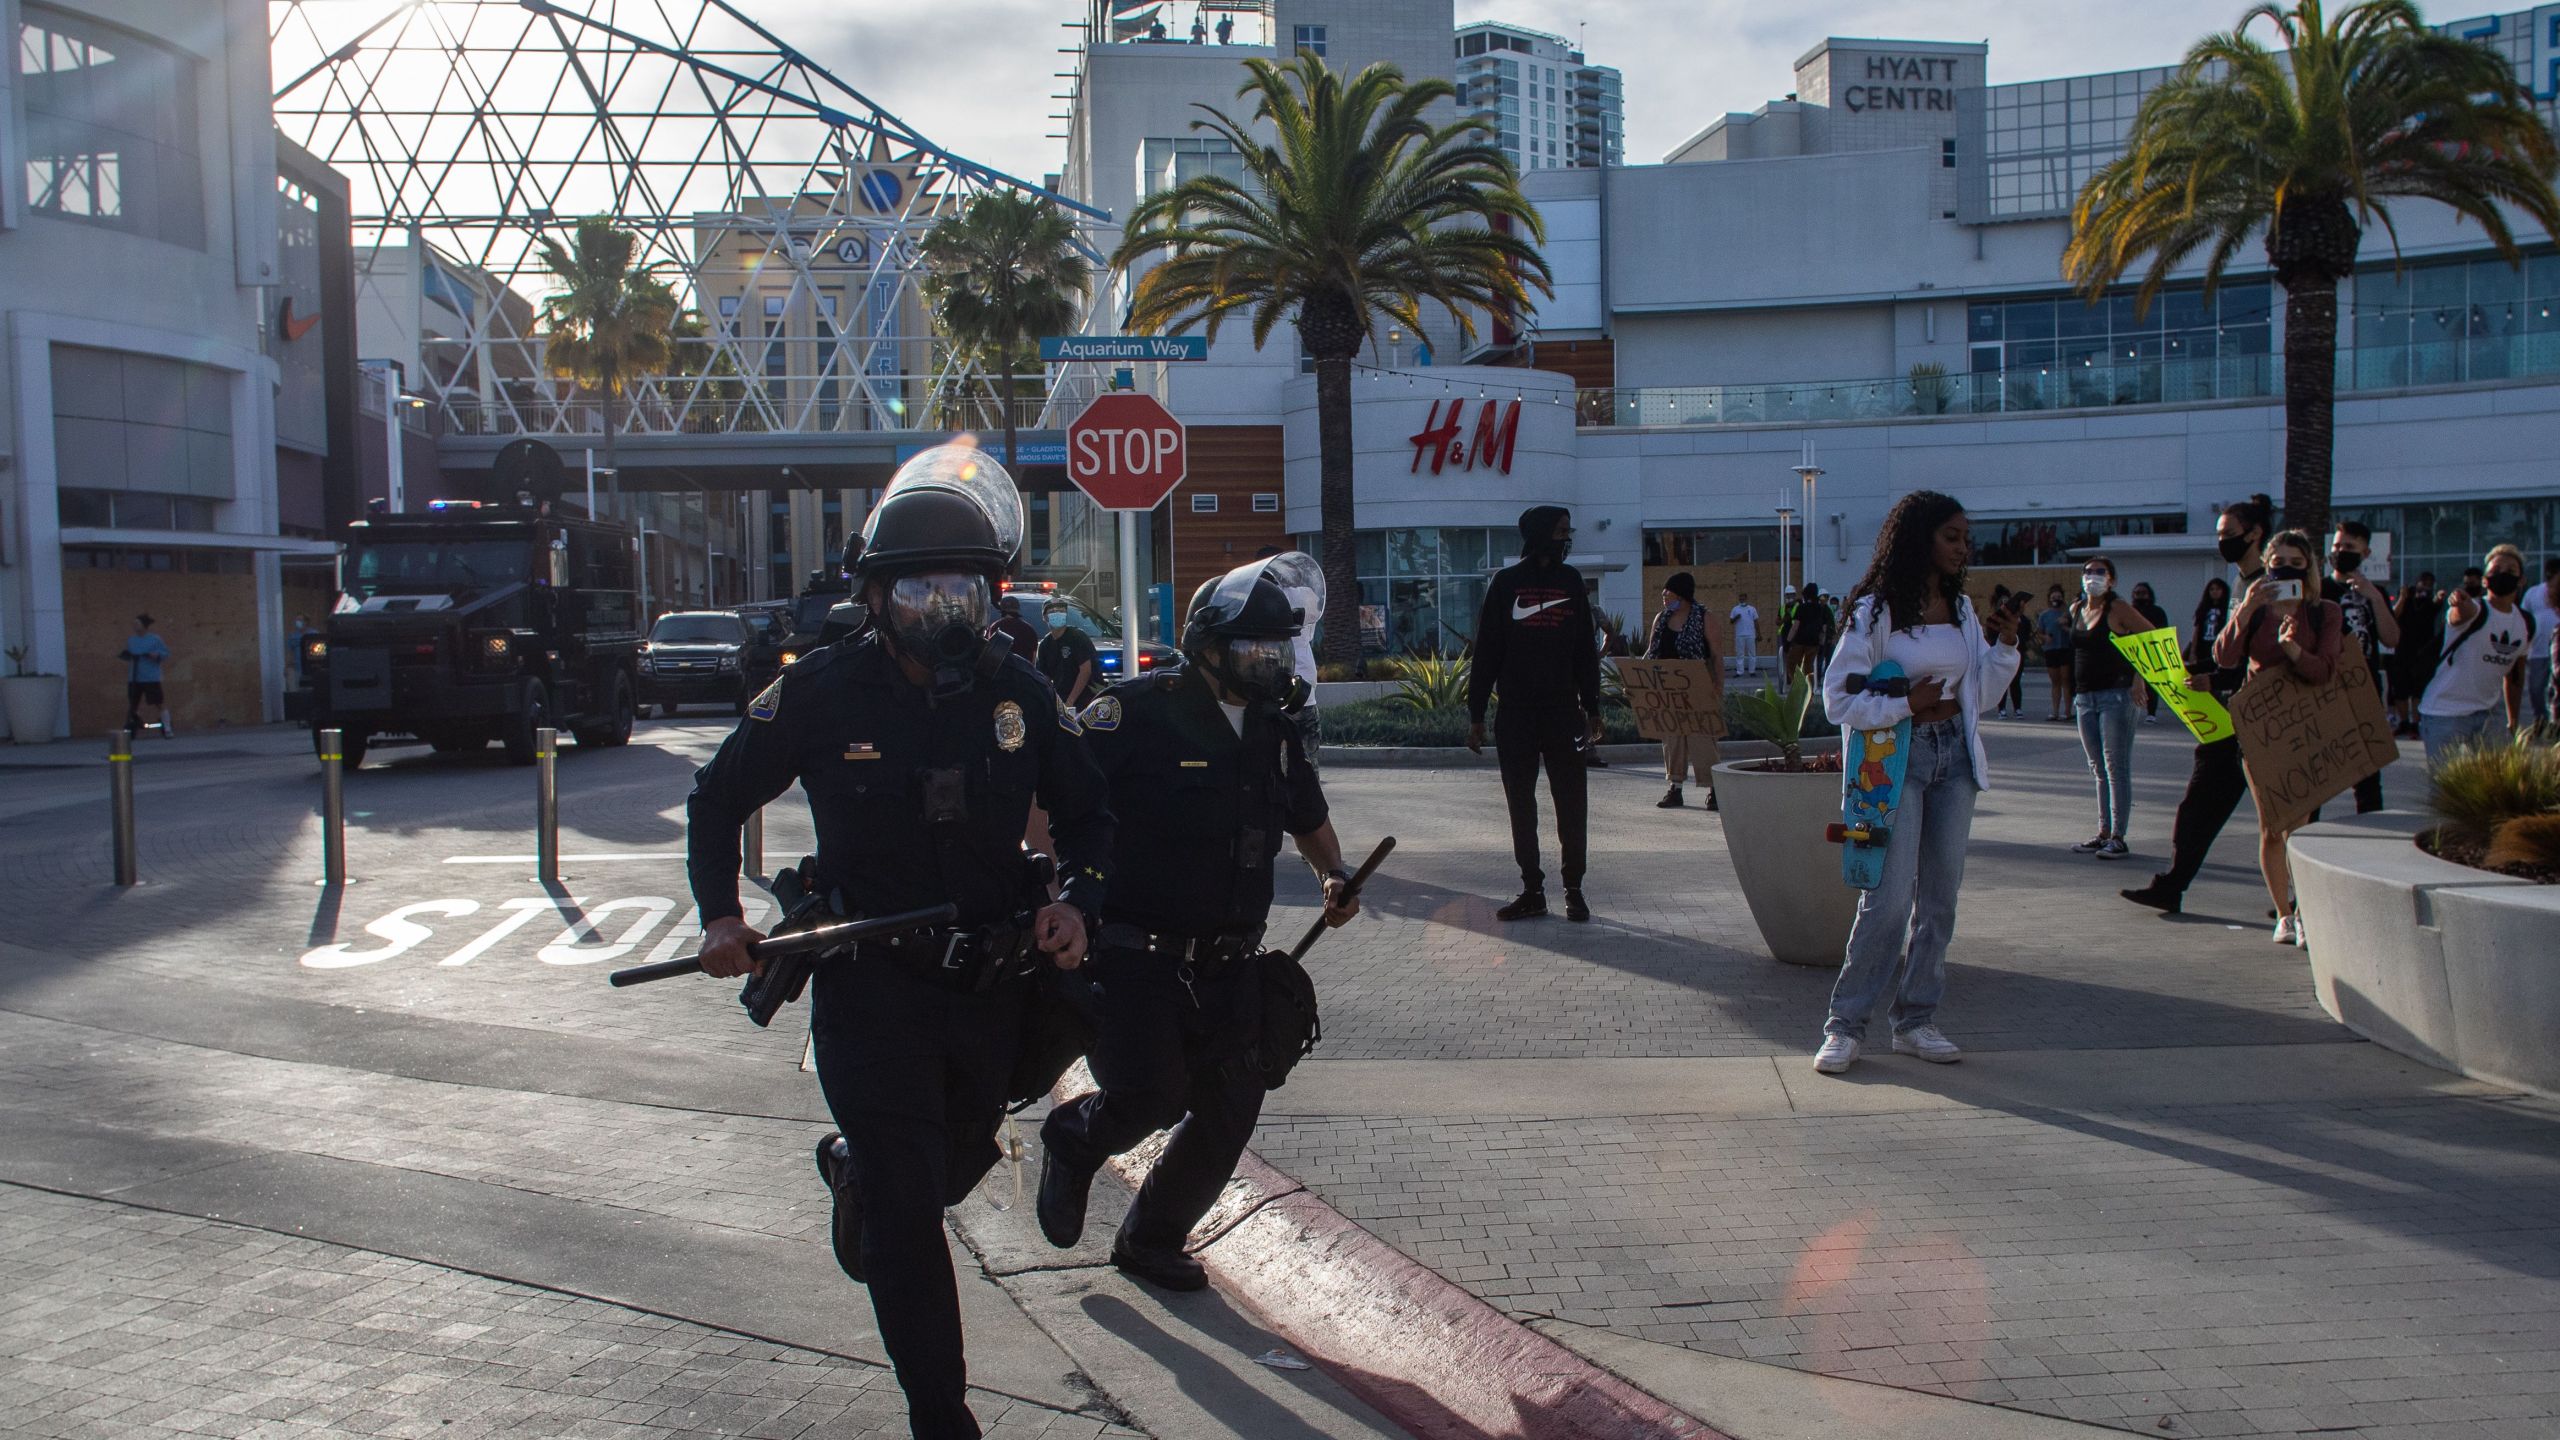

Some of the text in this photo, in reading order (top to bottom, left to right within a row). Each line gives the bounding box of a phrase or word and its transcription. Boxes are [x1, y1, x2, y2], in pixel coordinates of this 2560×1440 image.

[1866, 56, 1958, 81] HYATT
[1845, 85, 1957, 113] CENTRI
[1058, 340, 1190, 361] Aquarium Way
[1076, 428, 1179, 476] STOP
[1409, 397, 1521, 475] H&M
[1619, 666, 1692, 692] LIVES
[1644, 691, 1694, 711] OVER
[2238, 678, 2285, 727] KEEP
[2253, 697, 2314, 748] VOICE
[2288, 717, 2322, 752] IN
[2265, 721, 2386, 819] NOVEMBER
